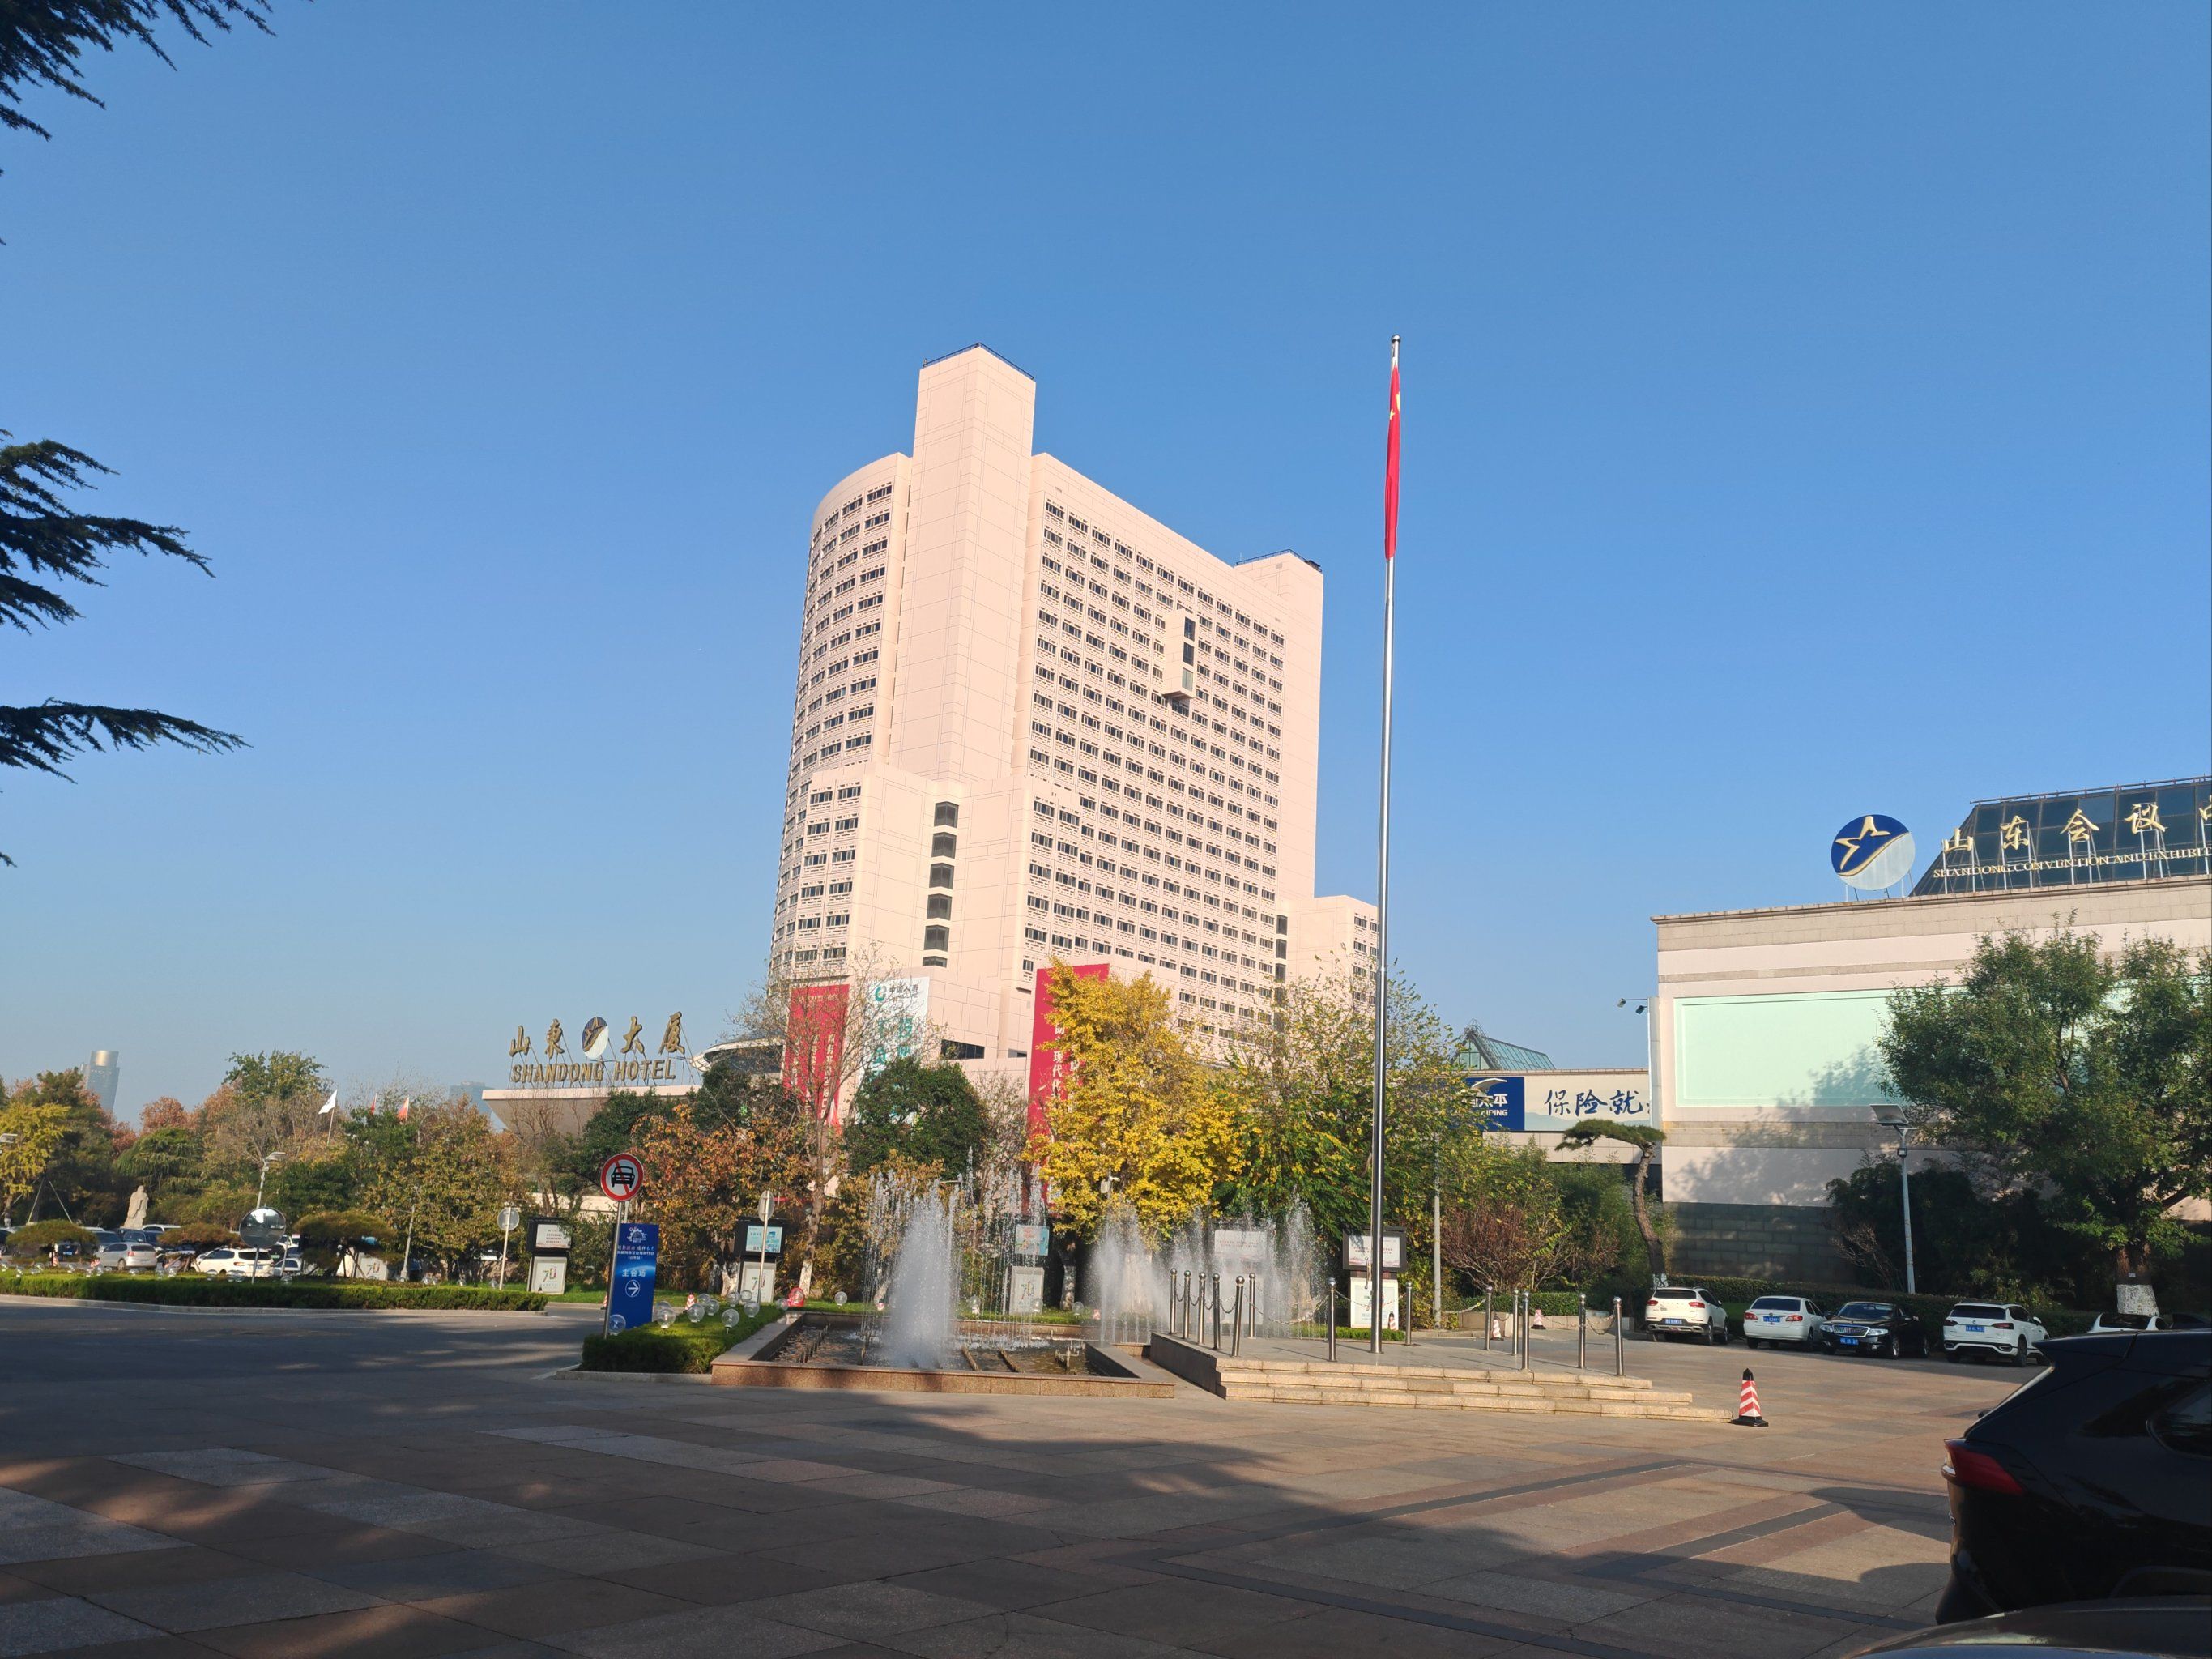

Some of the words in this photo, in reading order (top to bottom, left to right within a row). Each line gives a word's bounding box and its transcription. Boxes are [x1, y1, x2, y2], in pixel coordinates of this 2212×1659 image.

[1933, 865, 2010, 878] SHANDONG
[2013, 855, 2109, 872] CONVENTION
[2114, 853, 2146, 864] AND
[511, 1061, 604, 1083] SHANDONG
[614, 1059, 676, 1081] HOTEL
[1545, 1089, 1651, 1116] 保险就
